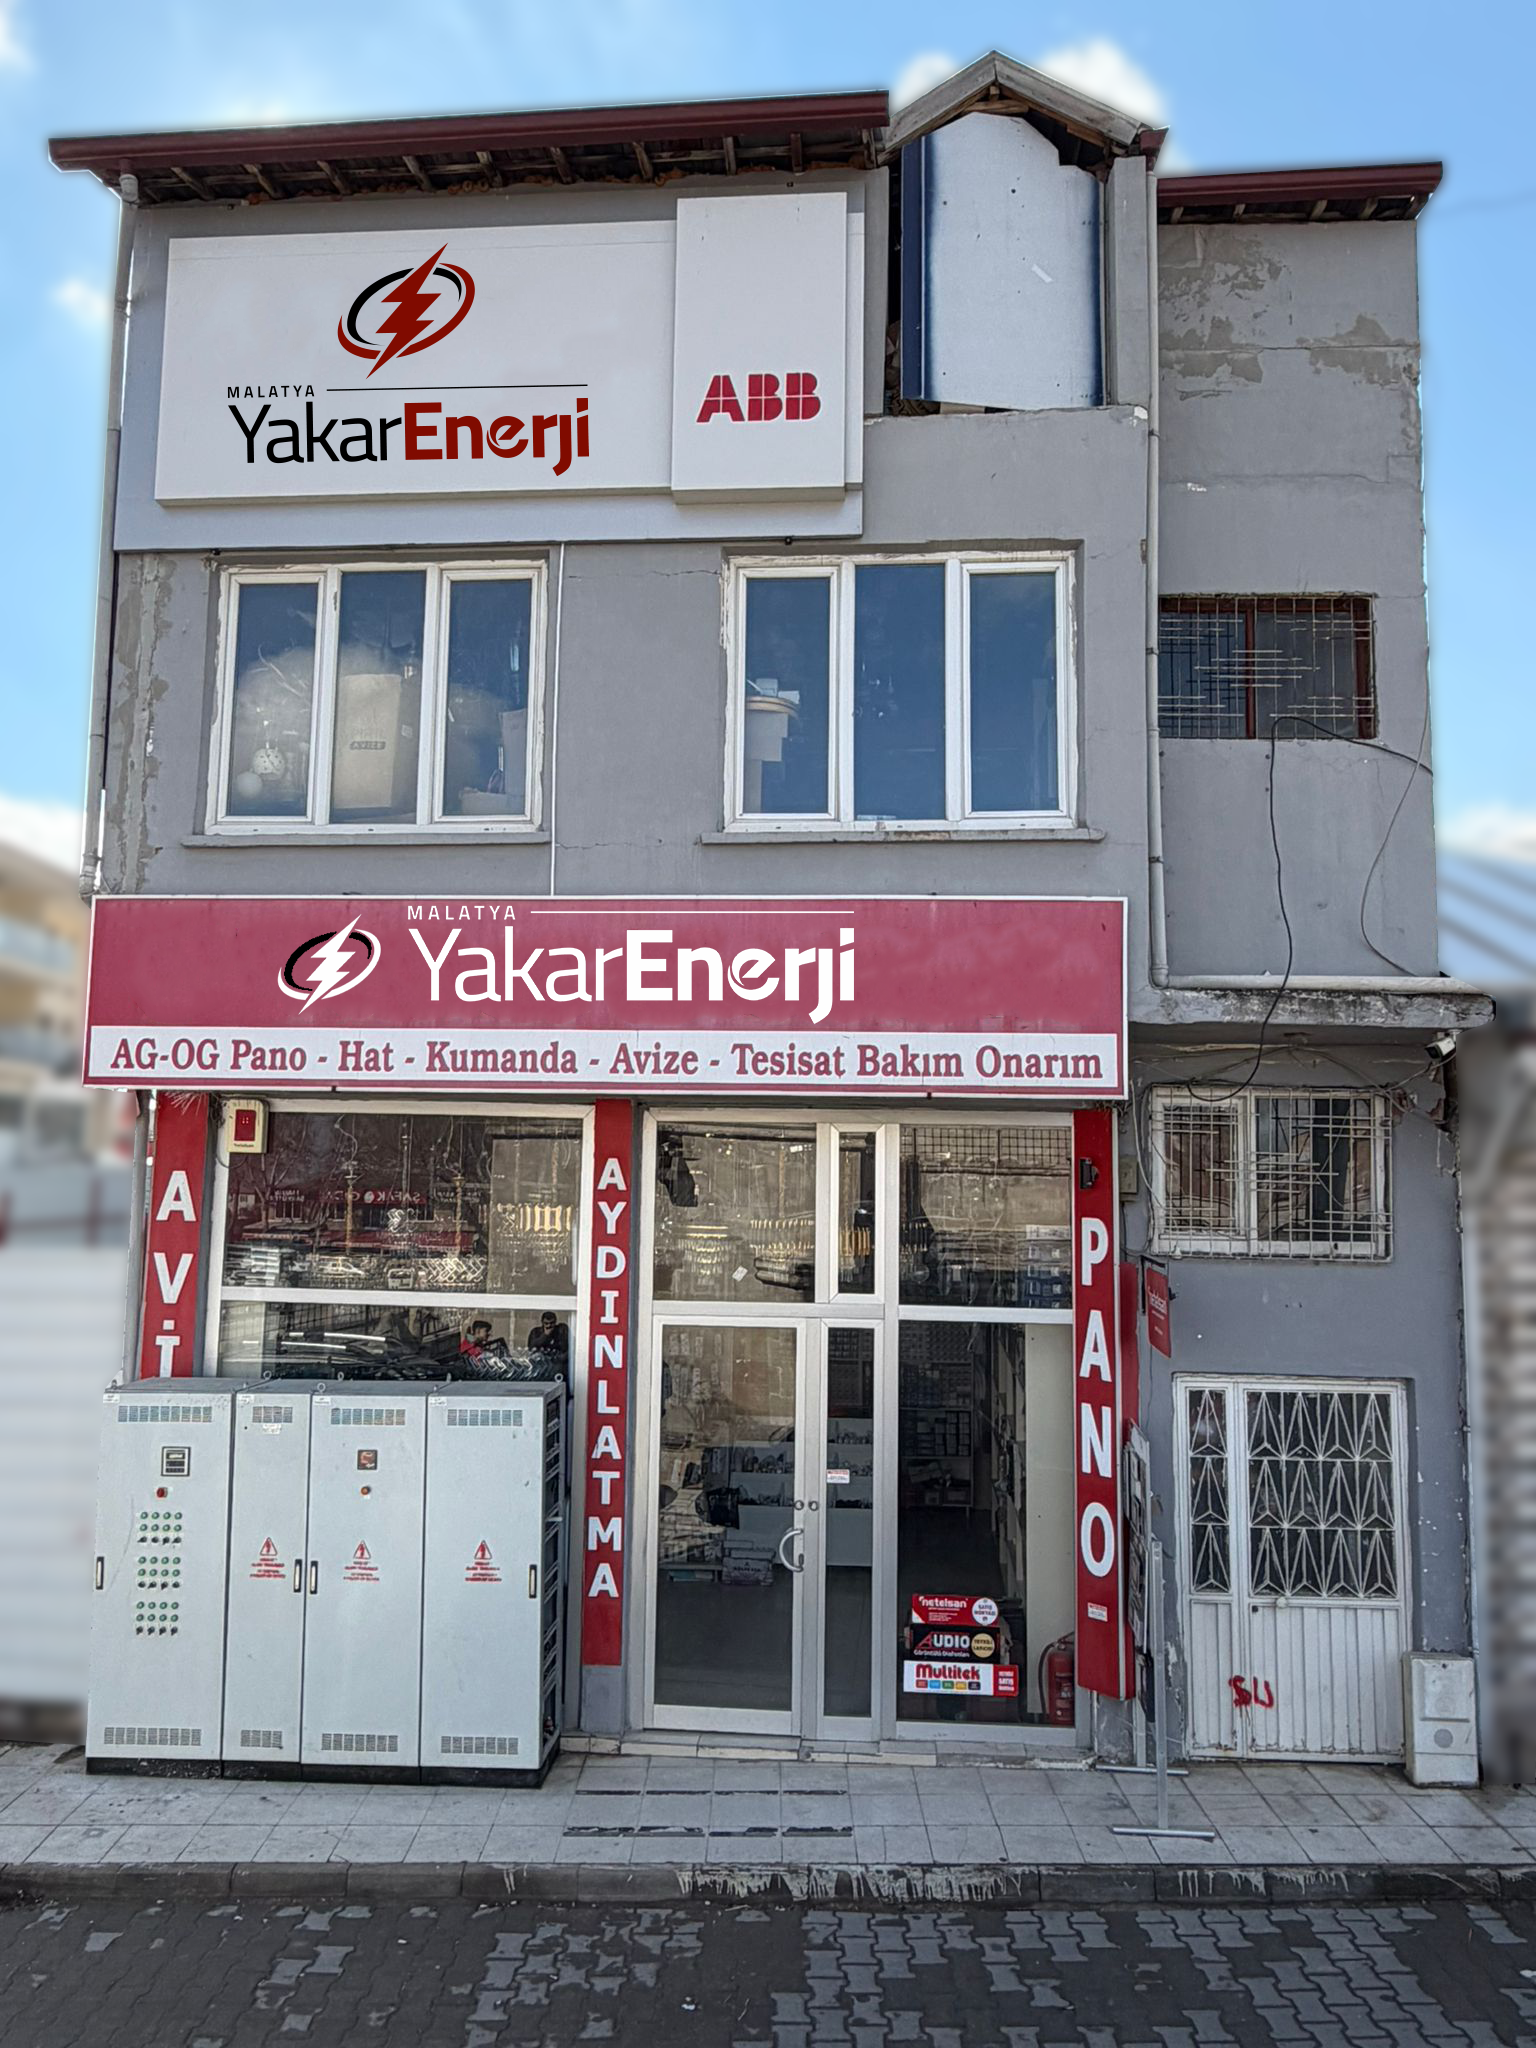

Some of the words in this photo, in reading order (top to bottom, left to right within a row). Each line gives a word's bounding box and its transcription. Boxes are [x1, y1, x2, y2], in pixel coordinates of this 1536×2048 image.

[227, 385, 315, 398] MALATYA
[696, 373, 821, 423] ABB
[227, 397, 590, 476] YakarEnerji
[408, 906, 516, 921] MALATYA
[408, 926, 855, 1025] YakarEnerji
[110, 1038, 220, 1071] AG-OG
[230, 1041, 307, 1072] Pano
[338, 1041, 394, 1073] Hat
[426, 1041, 578, 1074] Kumanda
[609, 1043, 699, 1076] Avize
[731, 1043, 846, 1078] Tesisat
[857, 1044, 964, 1079] Bakım
[975, 1046, 1104, 1079] Onarım
[587, 1157, 627, 1599] AYDINLATMA
[1079, 1216, 1115, 1578] PANO
[916, 1632, 971, 1649] AUDIO
[915, 1663, 981, 1681] Multitek
